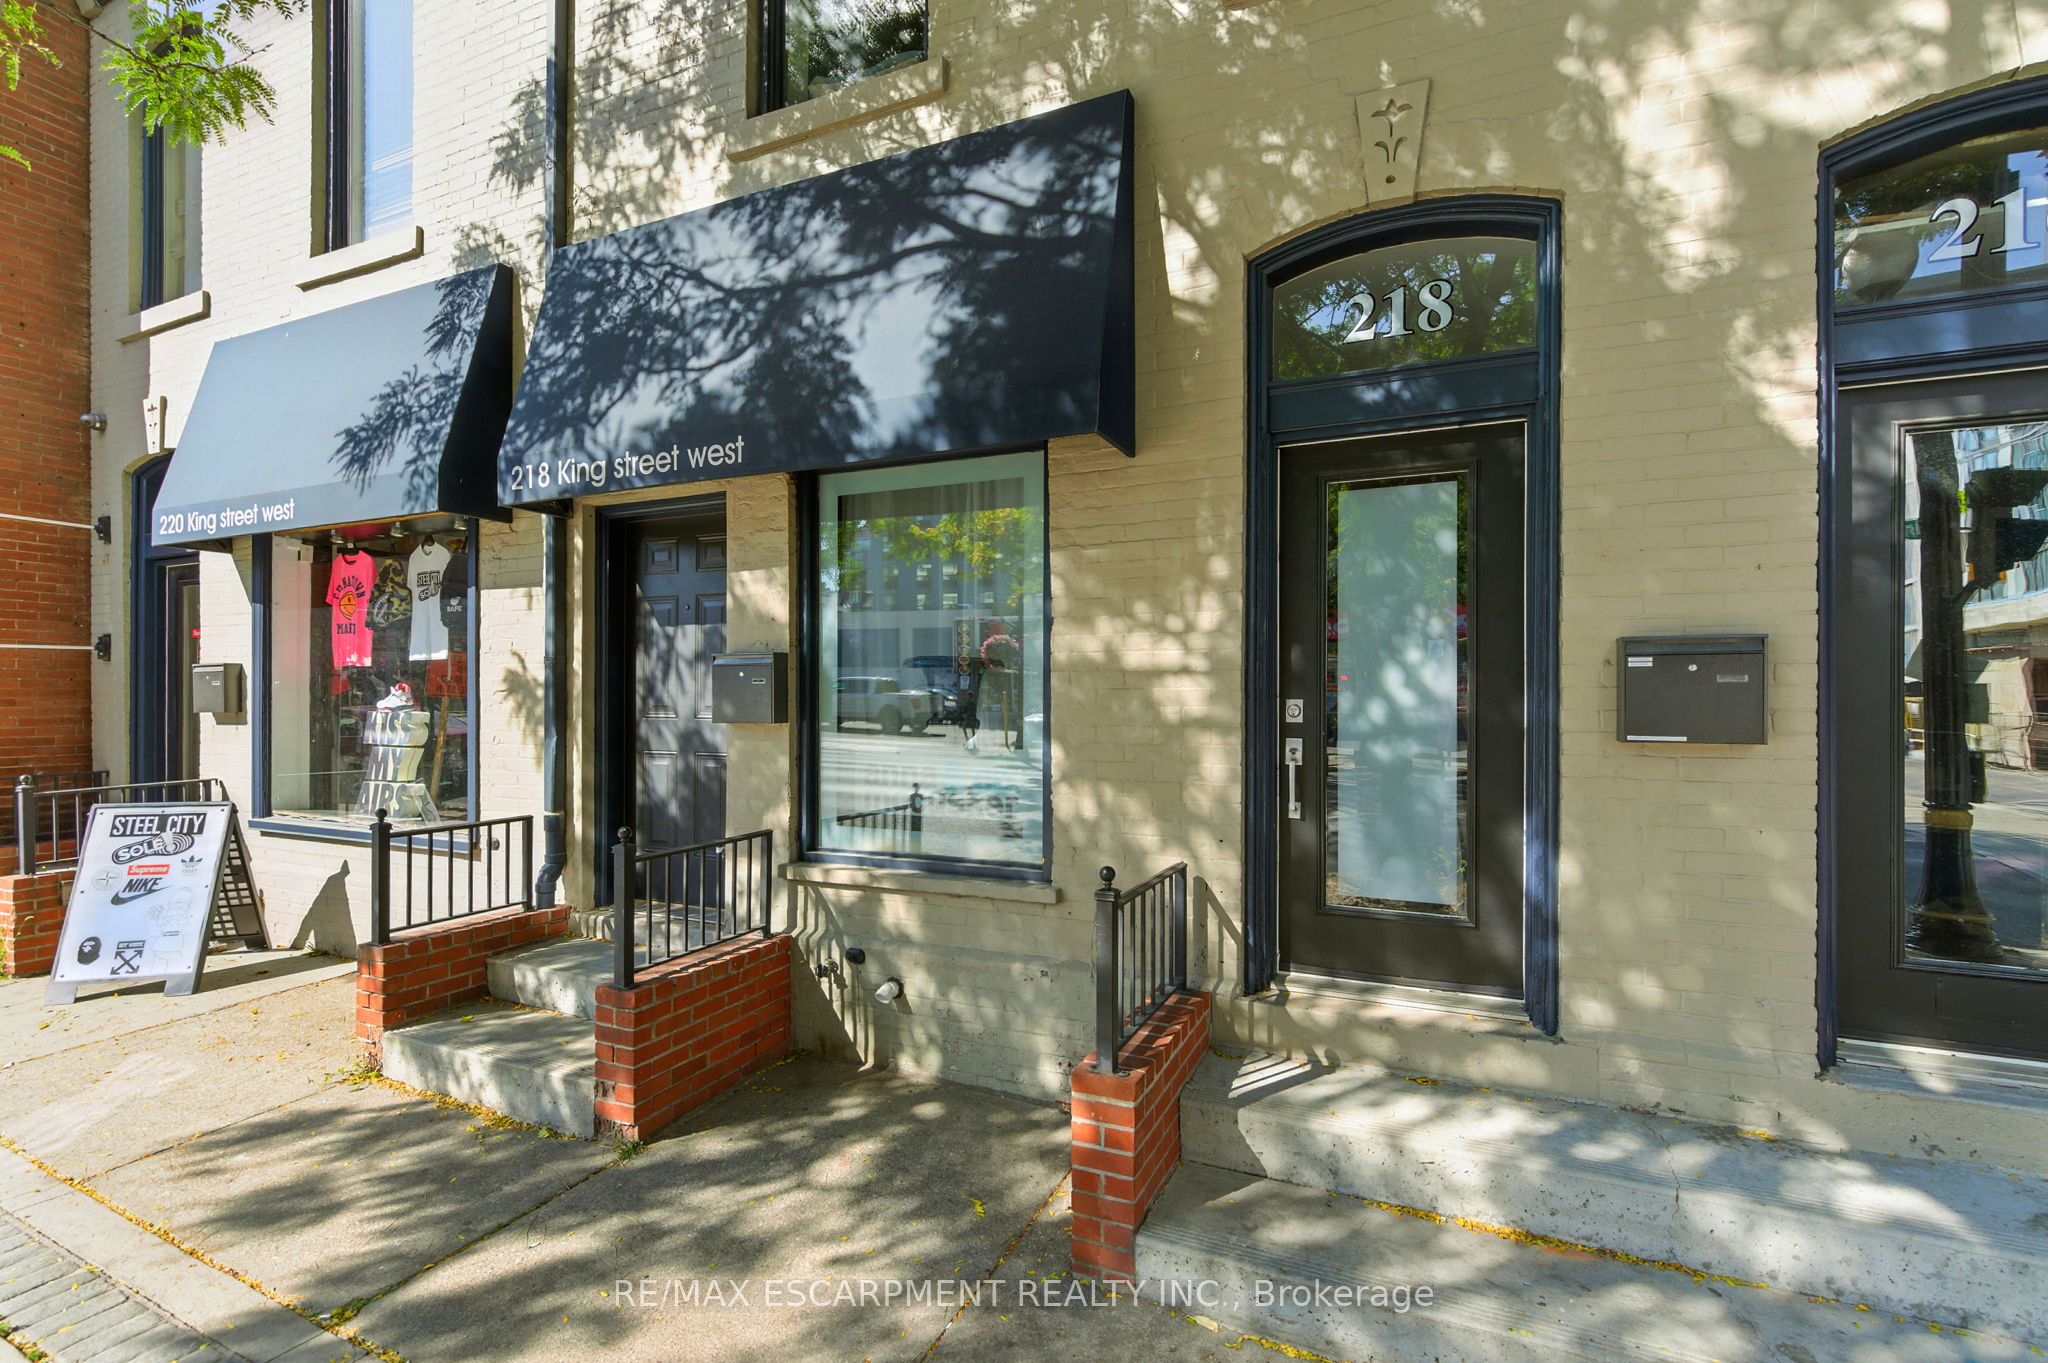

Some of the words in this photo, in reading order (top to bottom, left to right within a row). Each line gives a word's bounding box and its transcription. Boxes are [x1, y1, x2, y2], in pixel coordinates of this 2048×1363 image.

[1928, 187, 2048, 263] 21
[1343, 279, 1454, 344] 218
[511, 461, 550, 491] 218
[558, 458, 606, 487] King
[613, 444, 679, 479] street
[687, 435, 744, 469] west
[159, 513, 184, 535] 220
[187, 511, 217, 535] King
[219, 503, 259, 529] street
[262, 498, 295, 523] west
[112, 815, 161, 836] STEEL
[165, 814, 205, 834] CITY
[116, 838, 167, 861] SOLE
[122, 877, 163, 893] NIKE
[129, 865, 169, 875] Supreme
